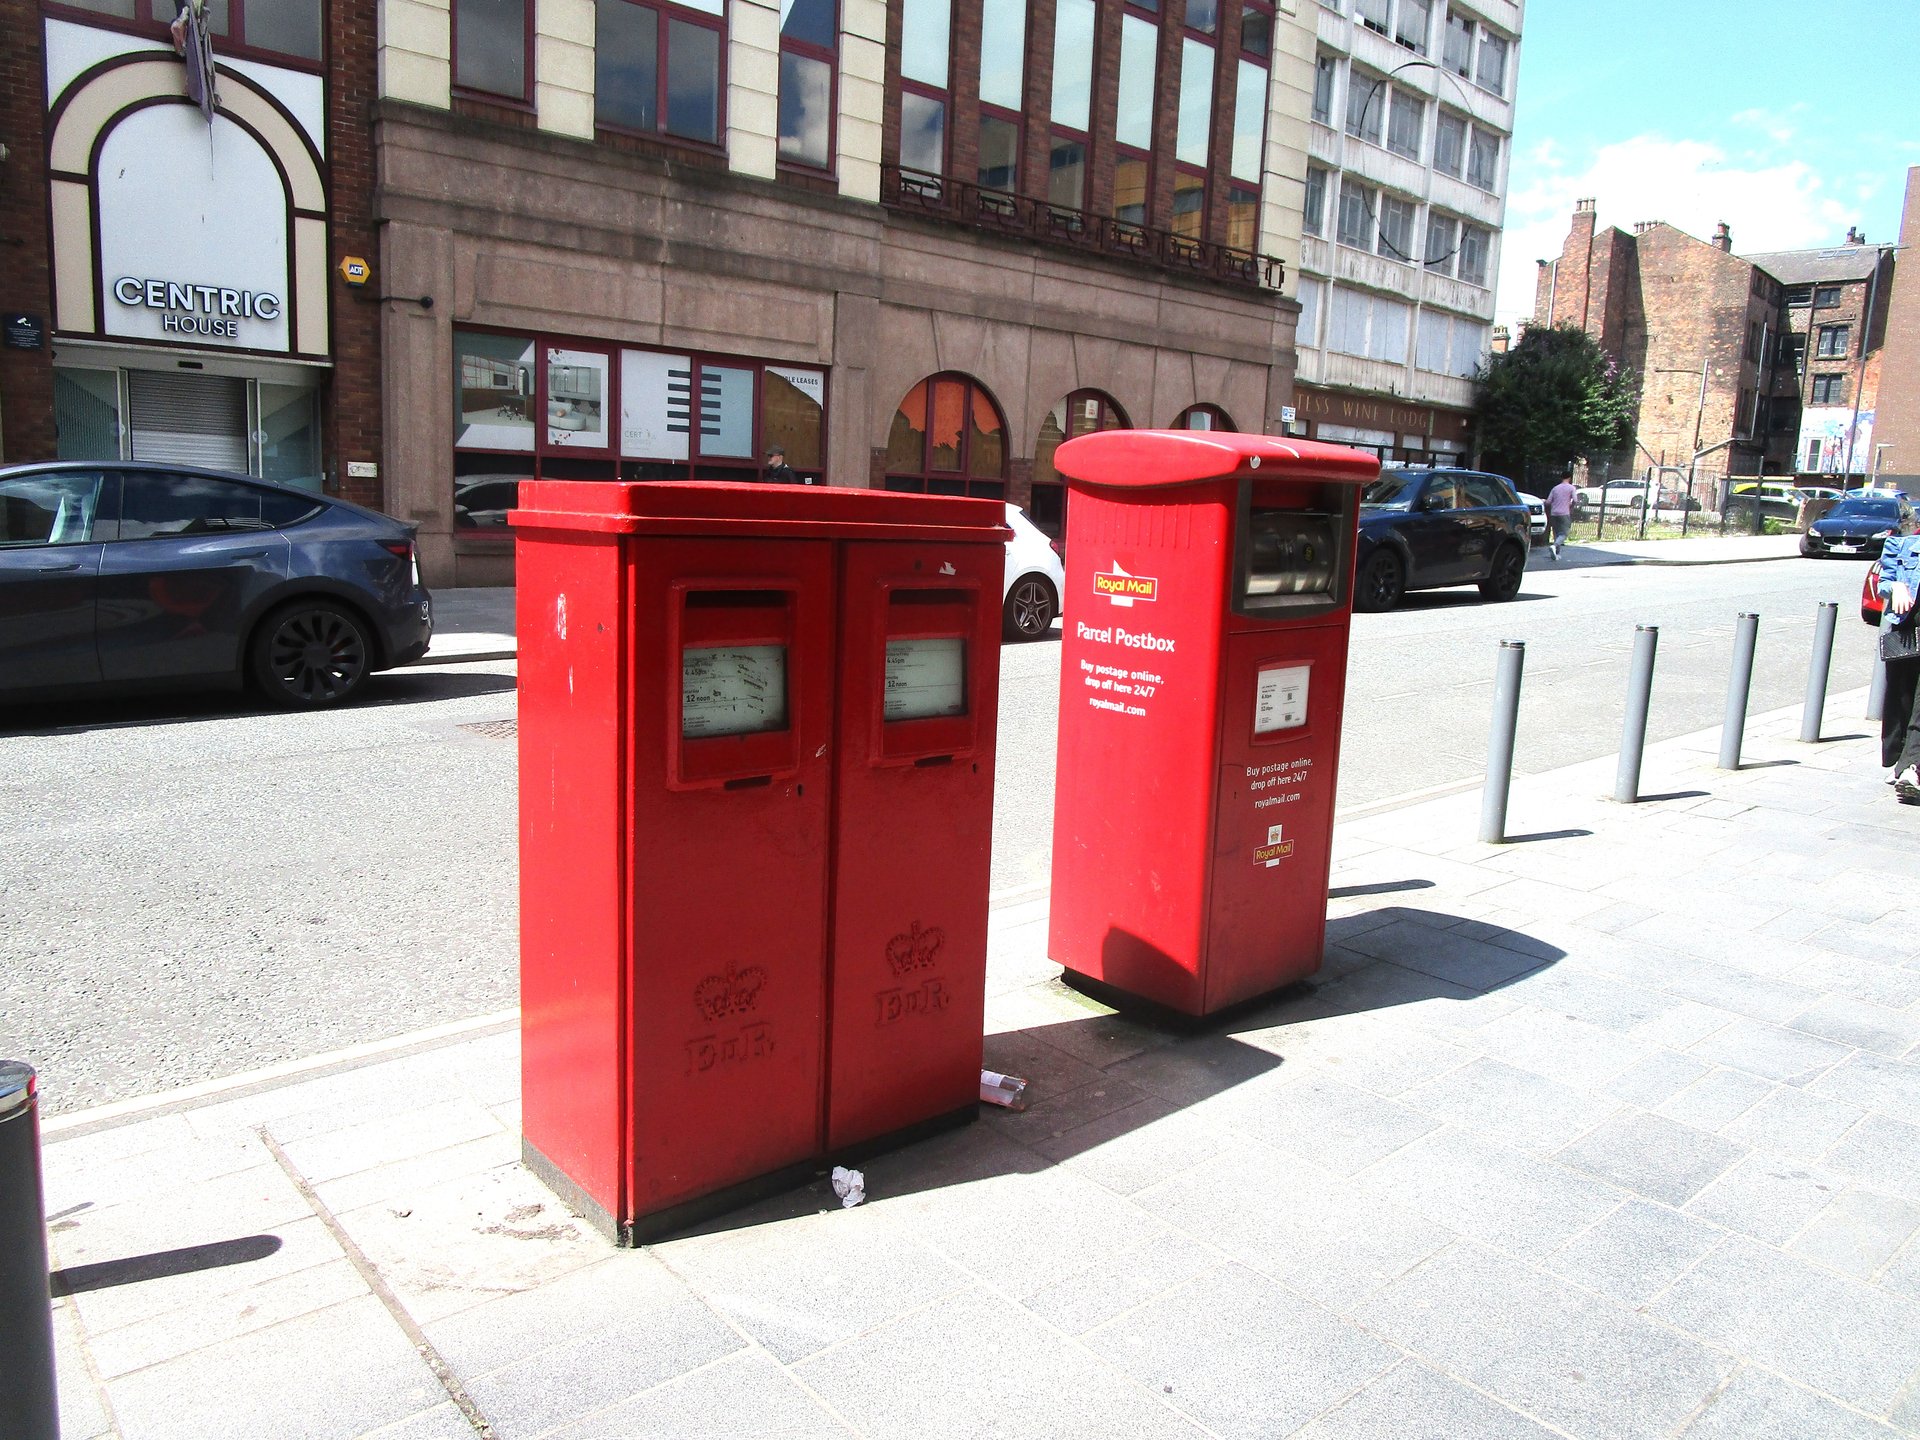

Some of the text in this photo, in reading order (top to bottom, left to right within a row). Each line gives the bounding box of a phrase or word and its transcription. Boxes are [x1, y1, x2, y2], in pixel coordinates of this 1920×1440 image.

[349, 265, 364, 276] ADT
[114, 276, 280, 320] CENTRIC
[163, 314, 238, 338] HOUSE
[796, 377, 819, 386] LEASES
[1097, 576, 1153, 594] Royal Mail
[1077, 621, 1175, 653] Parcel Postbox
[1080, 658, 1165, 685] Buy postage online,
[887, 680, 896, 688] 12
[1085, 675, 1155, 698] drop off here 24/7
[686, 694, 695, 703] 12
[1089, 697, 1146, 717] royalmail.com
[1246, 766, 1260, 778] Buy
[1261, 761, 1289, 776] postage
[1250, 770, 1307, 791] drop off here 24/7
[1254, 792, 1301, 810] royalmail.com
[1256, 843, 1292, 860] Royal Mail
